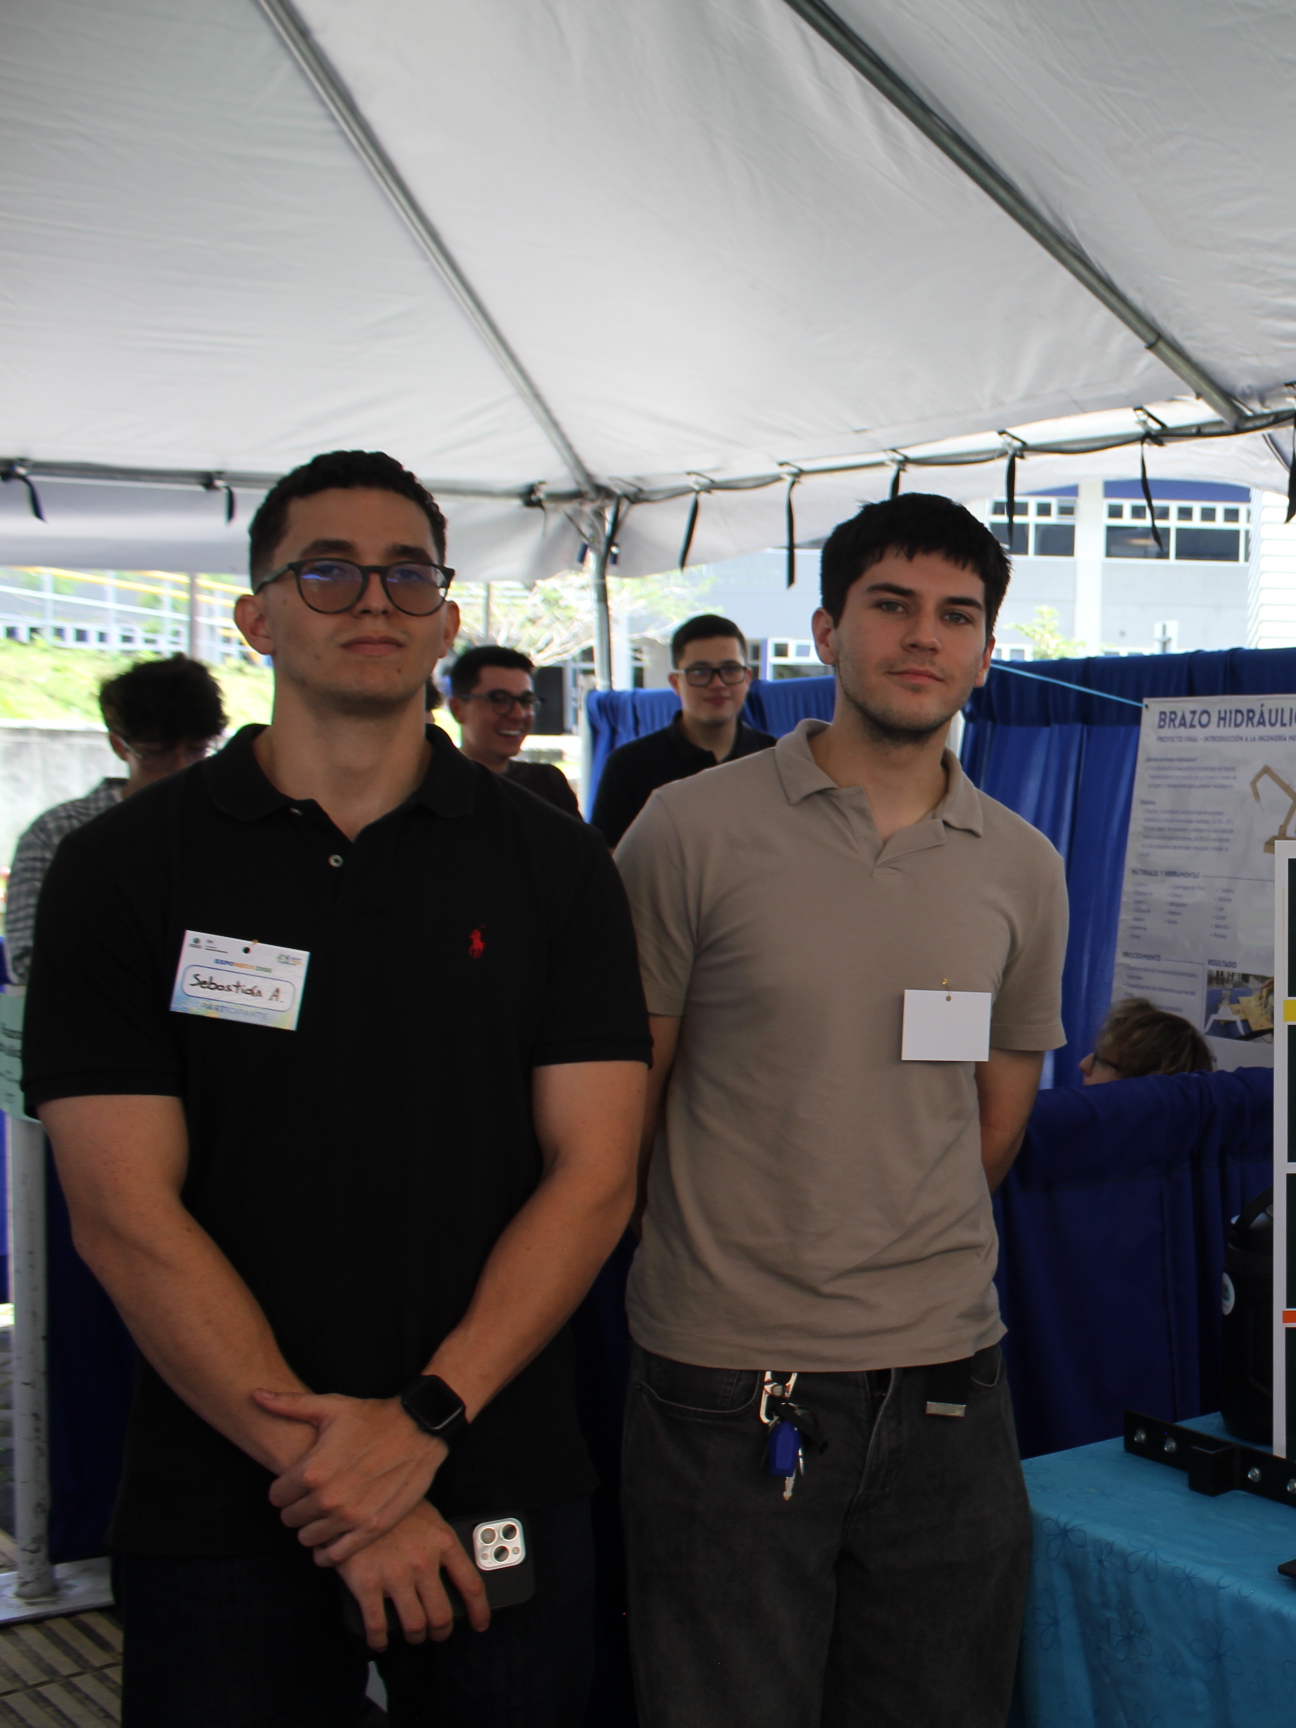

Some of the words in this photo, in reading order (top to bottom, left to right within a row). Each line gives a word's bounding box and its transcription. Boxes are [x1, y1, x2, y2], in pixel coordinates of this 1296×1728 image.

[1158, 709, 1211, 729] BRAZO
[1204, 734, 1243, 742] INTRODUCCIÓN
[1258, 734, 1287, 742] INGENIERÍA
[1208, 959, 1237, 968] RESULTADO
[269, 988, 284, 1003] A.
[201, 1002, 268, 1019] PARTICIPANTE
